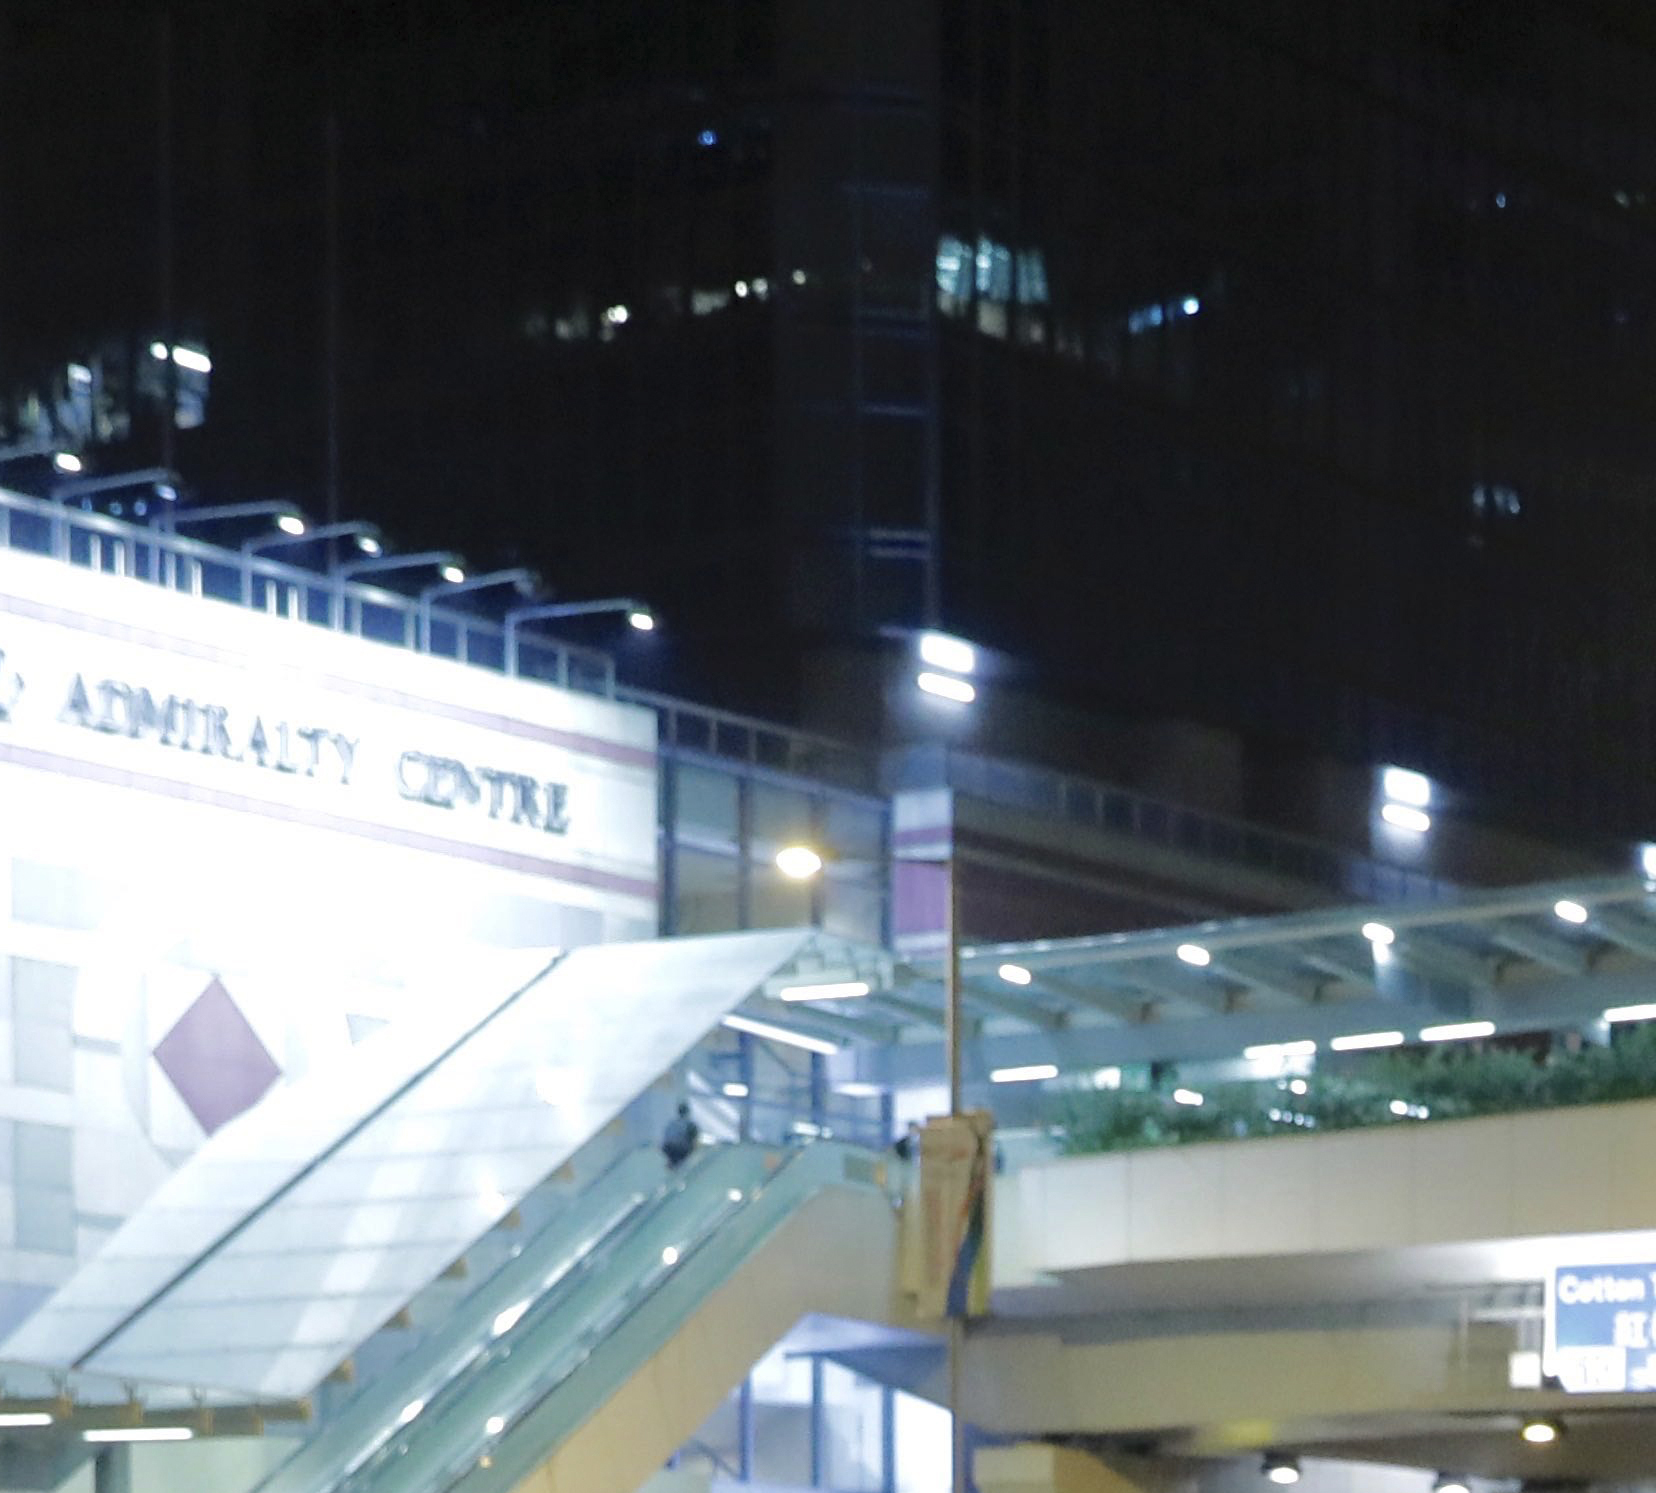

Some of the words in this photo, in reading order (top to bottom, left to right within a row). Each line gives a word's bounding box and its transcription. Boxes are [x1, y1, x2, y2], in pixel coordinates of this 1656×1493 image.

[56, 671, 360, 785] ADMIRALTY
[397, 749, 571, 836] CENTRE
[1557, 1274, 1646, 1305] Cotton
